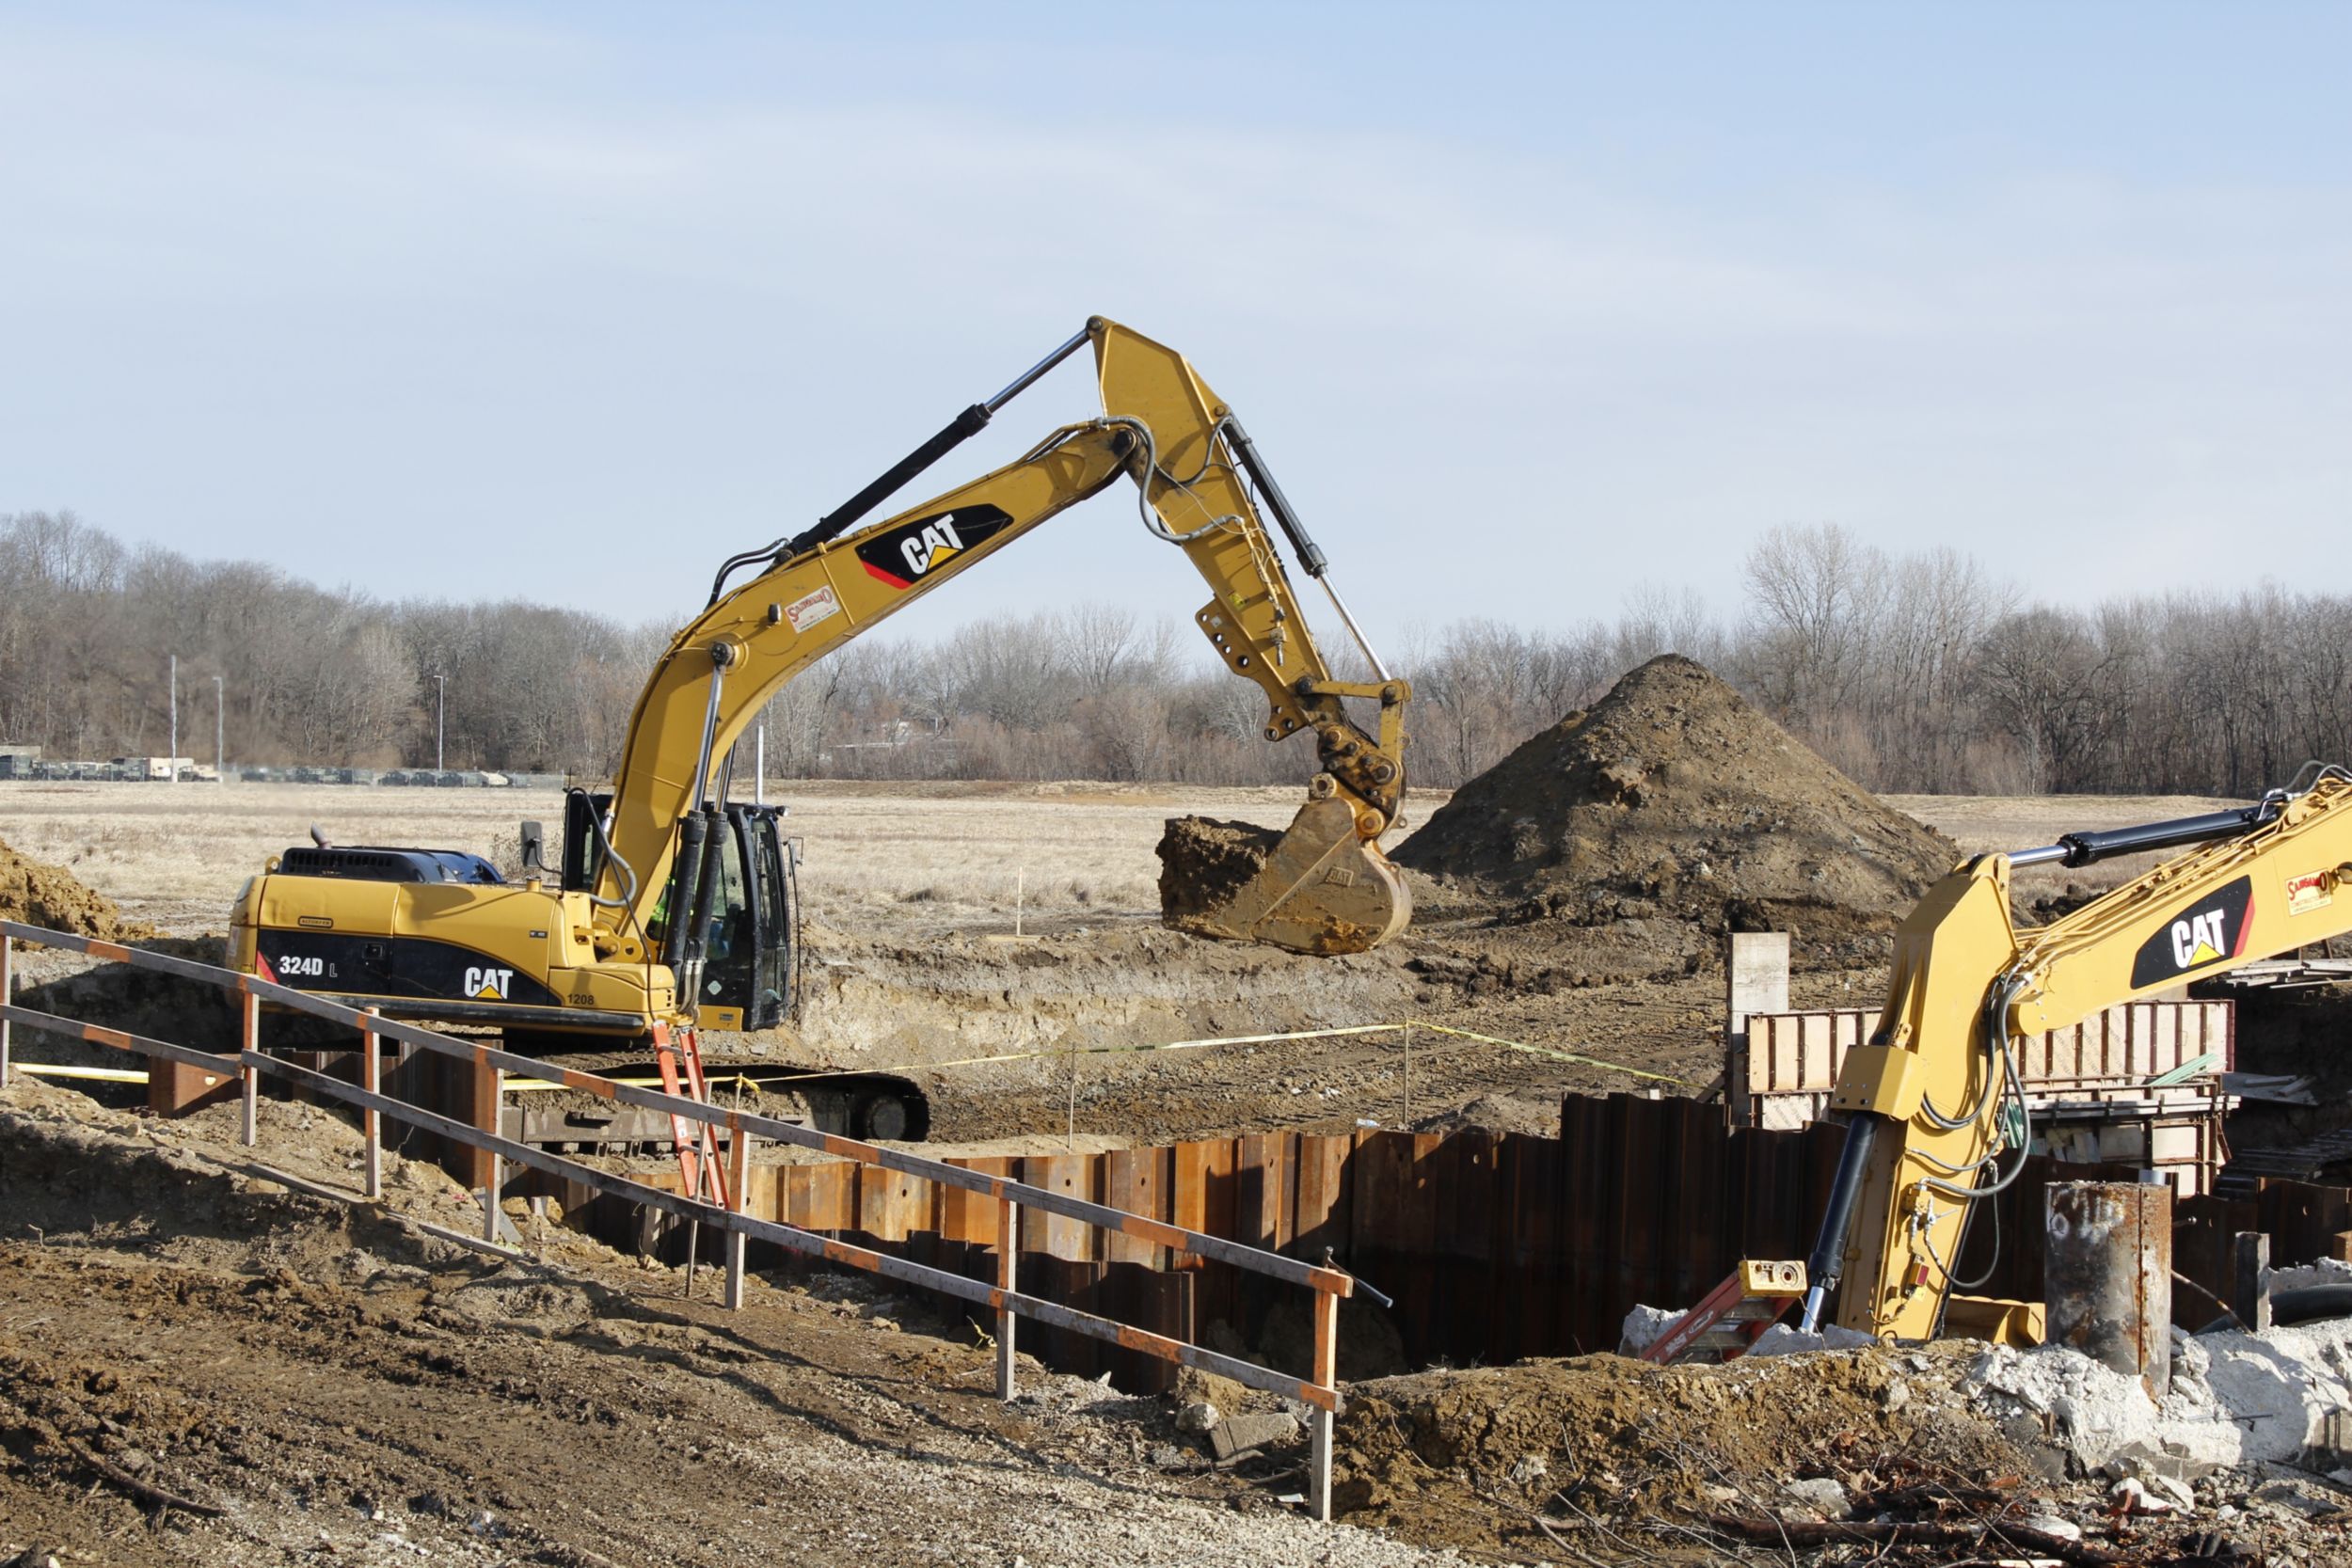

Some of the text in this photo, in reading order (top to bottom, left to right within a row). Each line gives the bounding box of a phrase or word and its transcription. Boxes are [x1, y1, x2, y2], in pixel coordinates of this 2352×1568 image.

[900, 514, 963, 575] CAT
[2171, 909, 2225, 969] CAT
[279, 956, 338, 978] 324D L
[464, 967, 514, 999] CAT
[567, 993, 595, 1005] 1208
